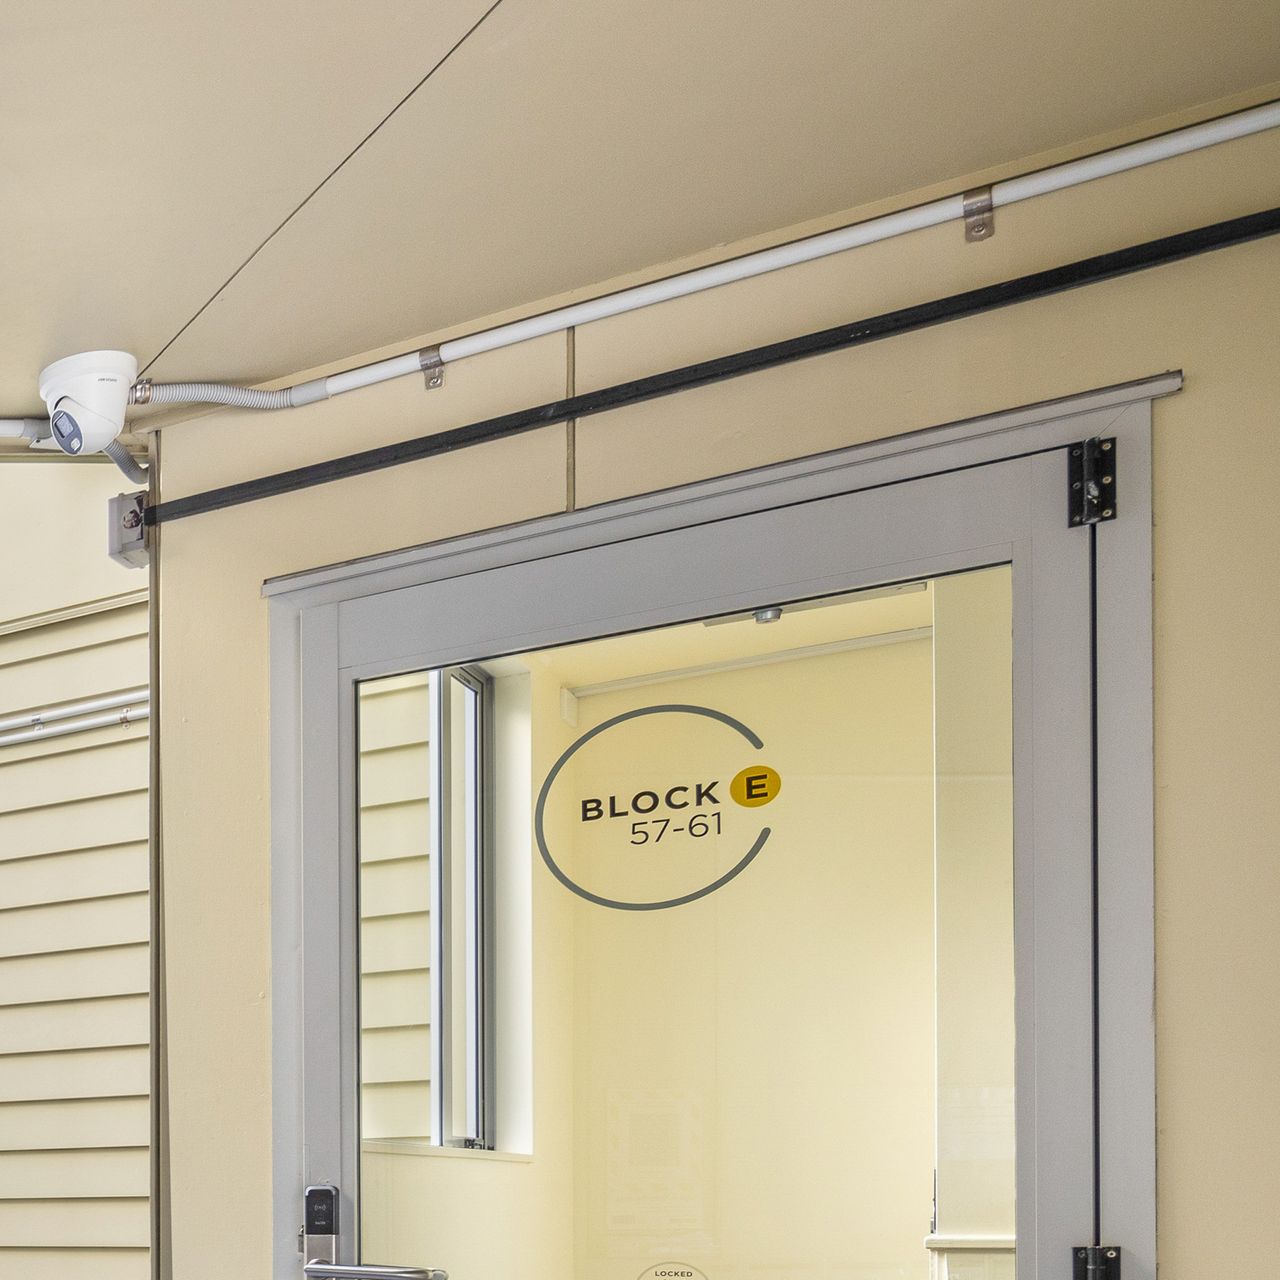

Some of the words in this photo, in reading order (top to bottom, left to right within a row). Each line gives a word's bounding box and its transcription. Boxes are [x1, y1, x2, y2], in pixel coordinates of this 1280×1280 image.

[581, 780, 720, 822] BLOCK
[745, 773, 769, 800] E
[629, 811, 722, 845] 57-61
